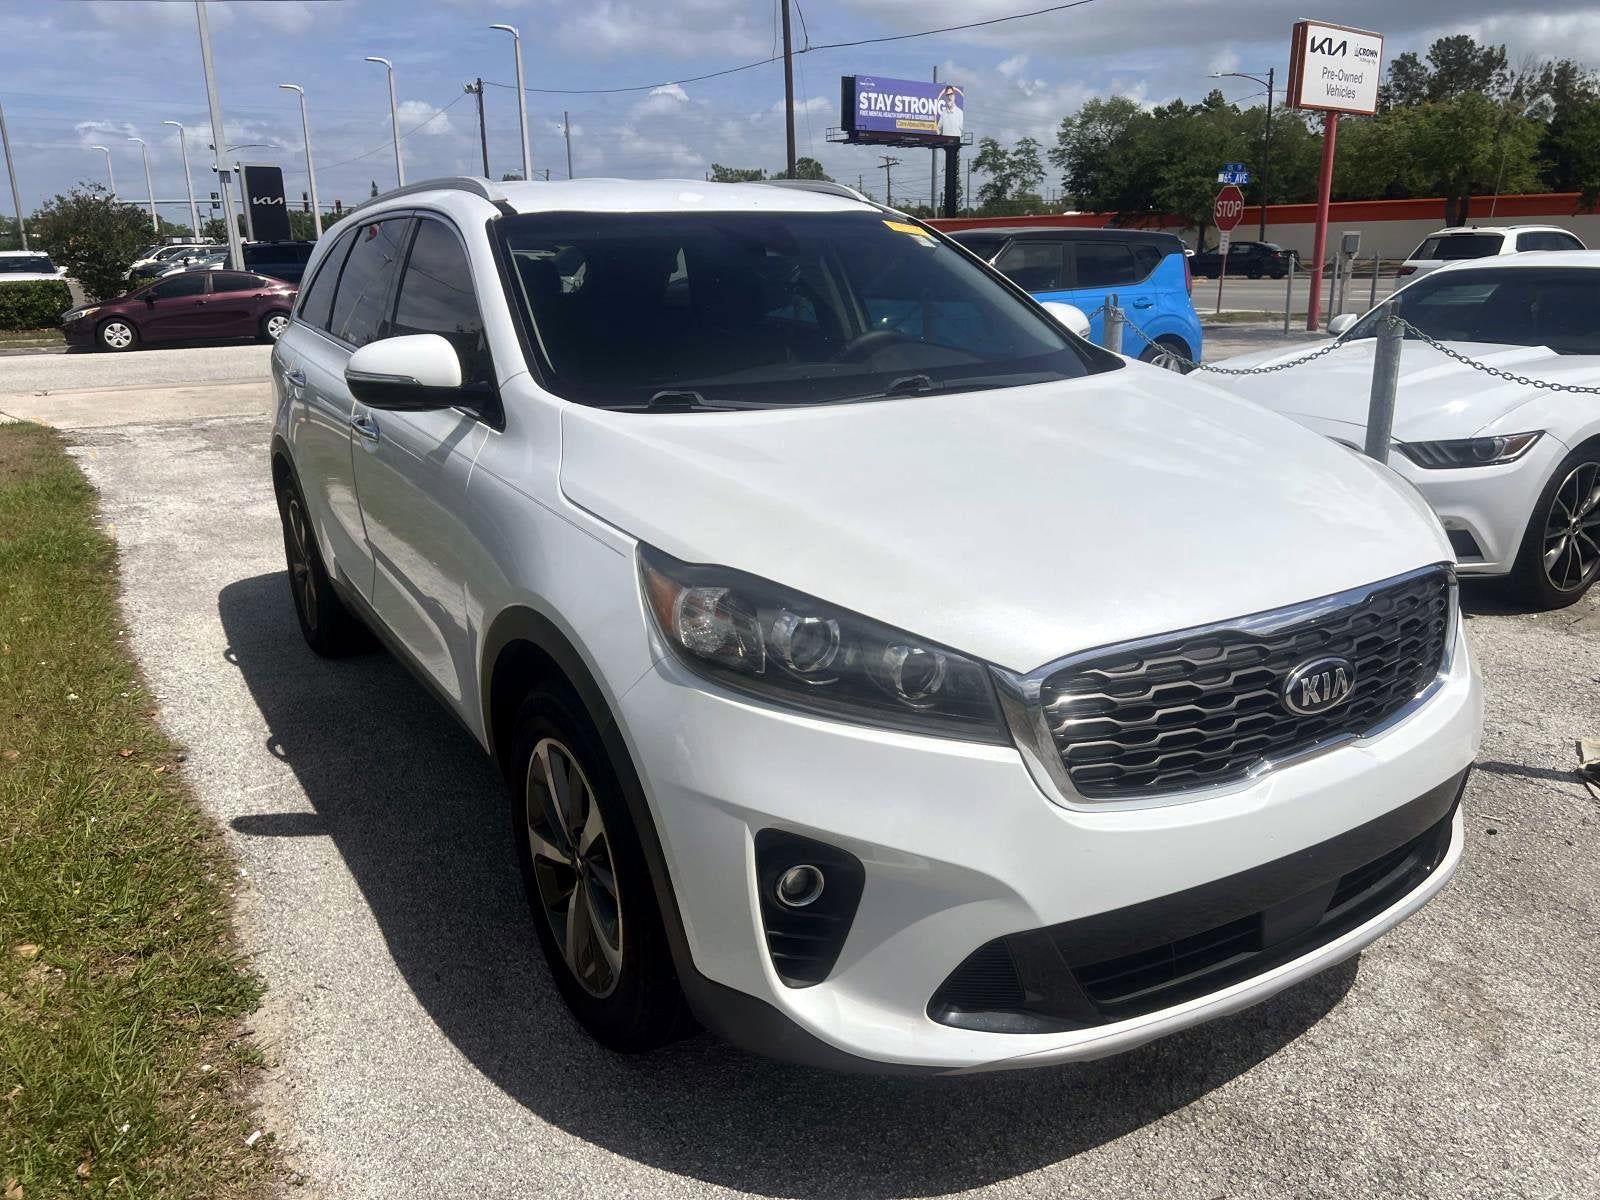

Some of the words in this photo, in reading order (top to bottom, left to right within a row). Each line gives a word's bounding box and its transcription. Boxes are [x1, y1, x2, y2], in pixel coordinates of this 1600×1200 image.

[1358, 47, 1378, 59] CROWN
[1322, 66, 1363, 84] Pre-Owned
[1326, 83, 1356, 99] Vehicles
[859, 92, 893, 111] STAY
[894, 95, 947, 115] STRONG
[1234, 173, 1248, 184] AVE
[1216, 200, 1242, 217] STOP
[1301, 667, 1348, 706] KIA
